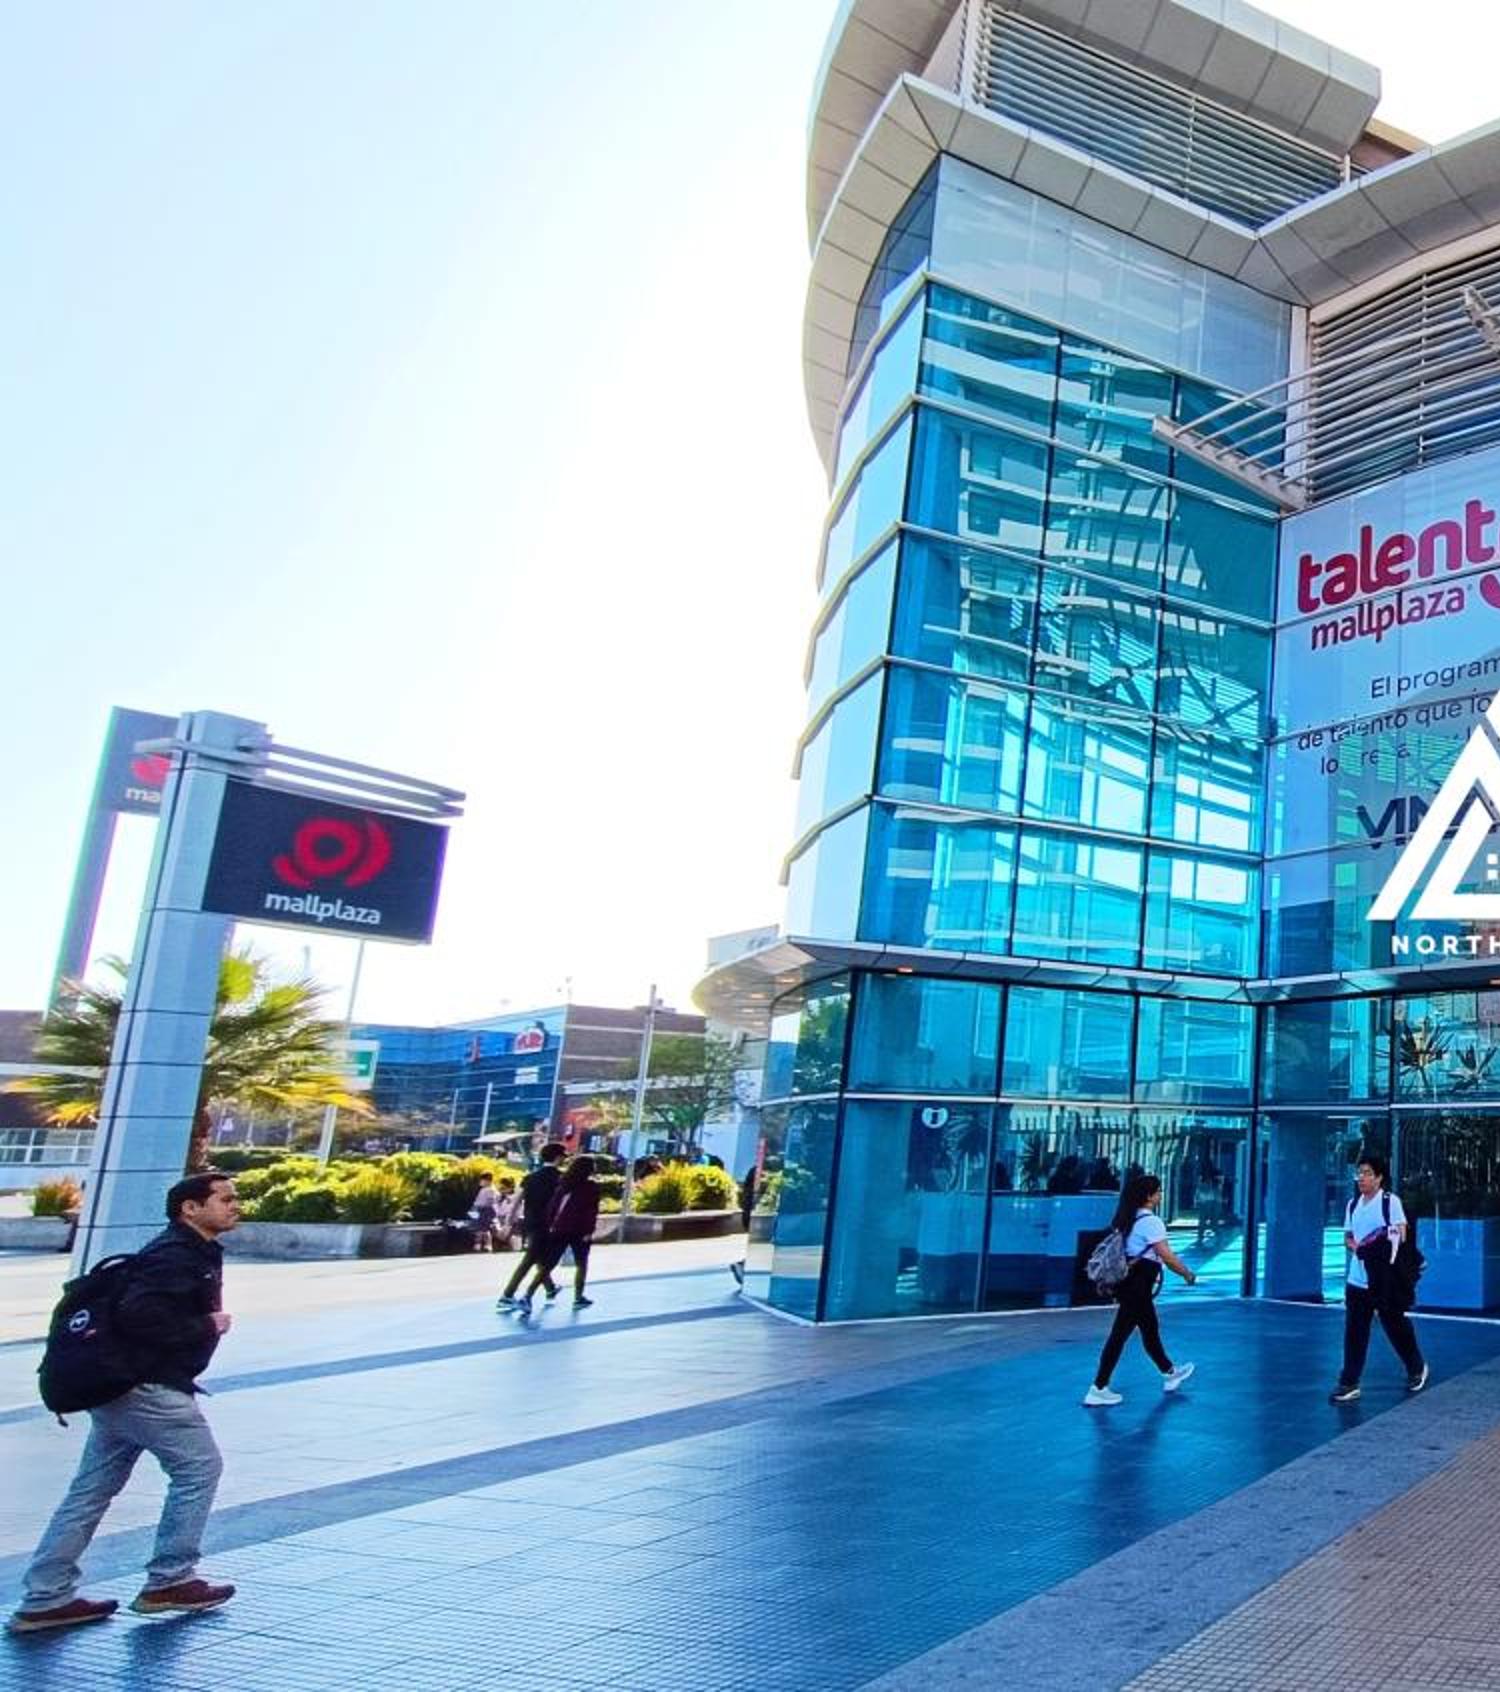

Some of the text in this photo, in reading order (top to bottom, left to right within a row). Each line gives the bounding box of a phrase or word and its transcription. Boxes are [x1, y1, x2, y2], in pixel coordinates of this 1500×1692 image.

[1310, 583, 1466, 651] mallplaza
[1371, 678, 1391, 700] El
[1298, 724, 1323, 750] de
[1415, 700, 1463, 727] que
[265, 892, 382, 925] mallplaza
